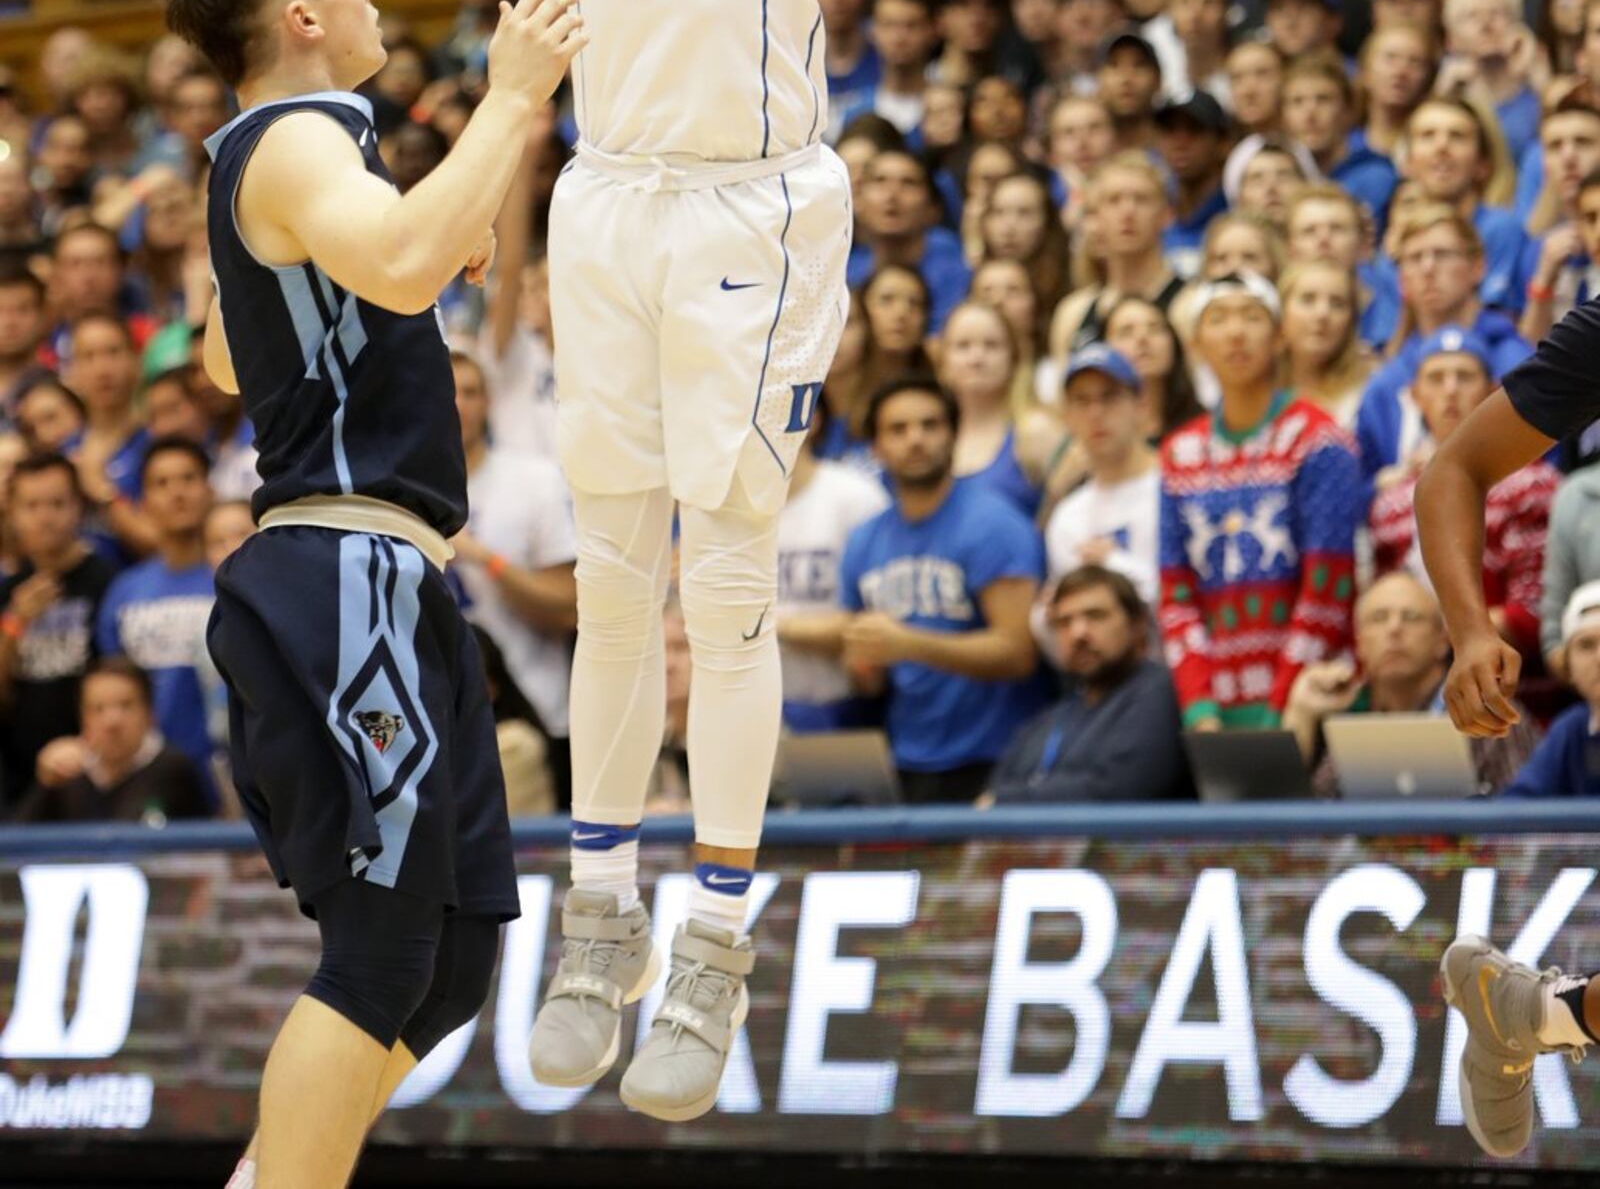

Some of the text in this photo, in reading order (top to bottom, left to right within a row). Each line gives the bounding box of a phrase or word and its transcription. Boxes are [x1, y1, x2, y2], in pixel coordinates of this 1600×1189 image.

[0, 863, 149, 1058] D
[385, 863, 1598, 1128] UKE BASK
